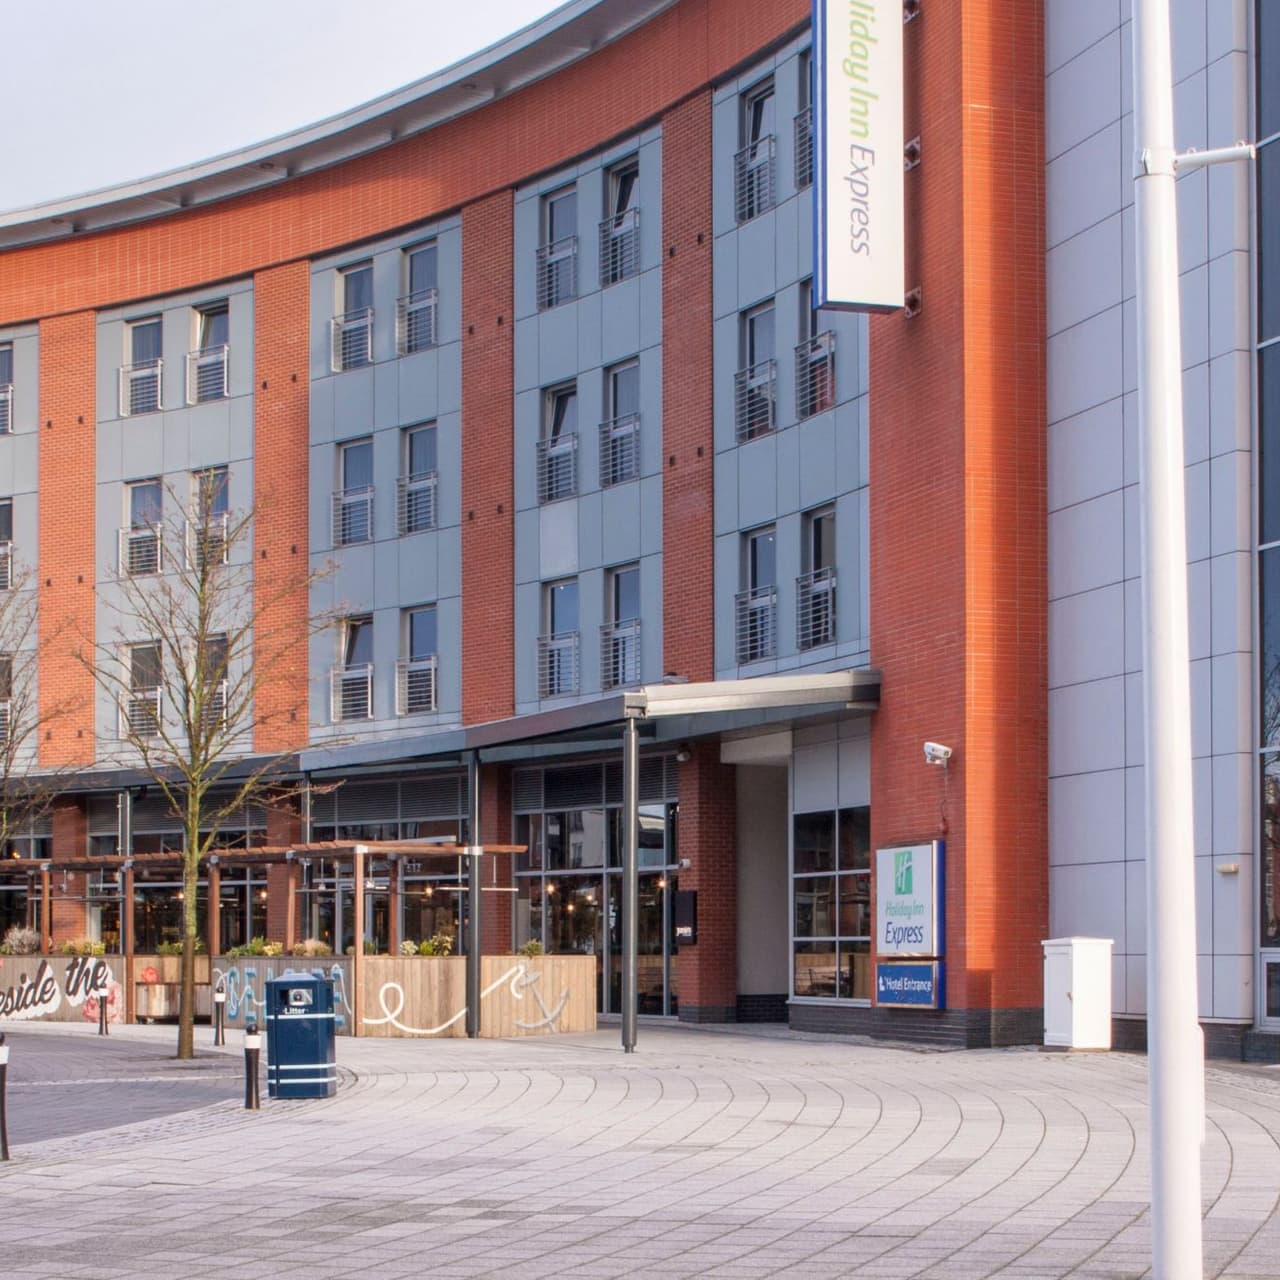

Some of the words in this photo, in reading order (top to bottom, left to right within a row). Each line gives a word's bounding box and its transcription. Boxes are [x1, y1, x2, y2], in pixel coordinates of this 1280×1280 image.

[849, 87, 879, 139] Inn
[843, 143, 876, 257] Express
[885, 900, 912, 919] Holiday
[885, 921, 924, 949] Express
[66, 956, 109, 997] the
[886, 976, 903, 991] Hotel
[903, 977, 932, 993] Entrance
[284, 1007, 306, 1016] Litter
